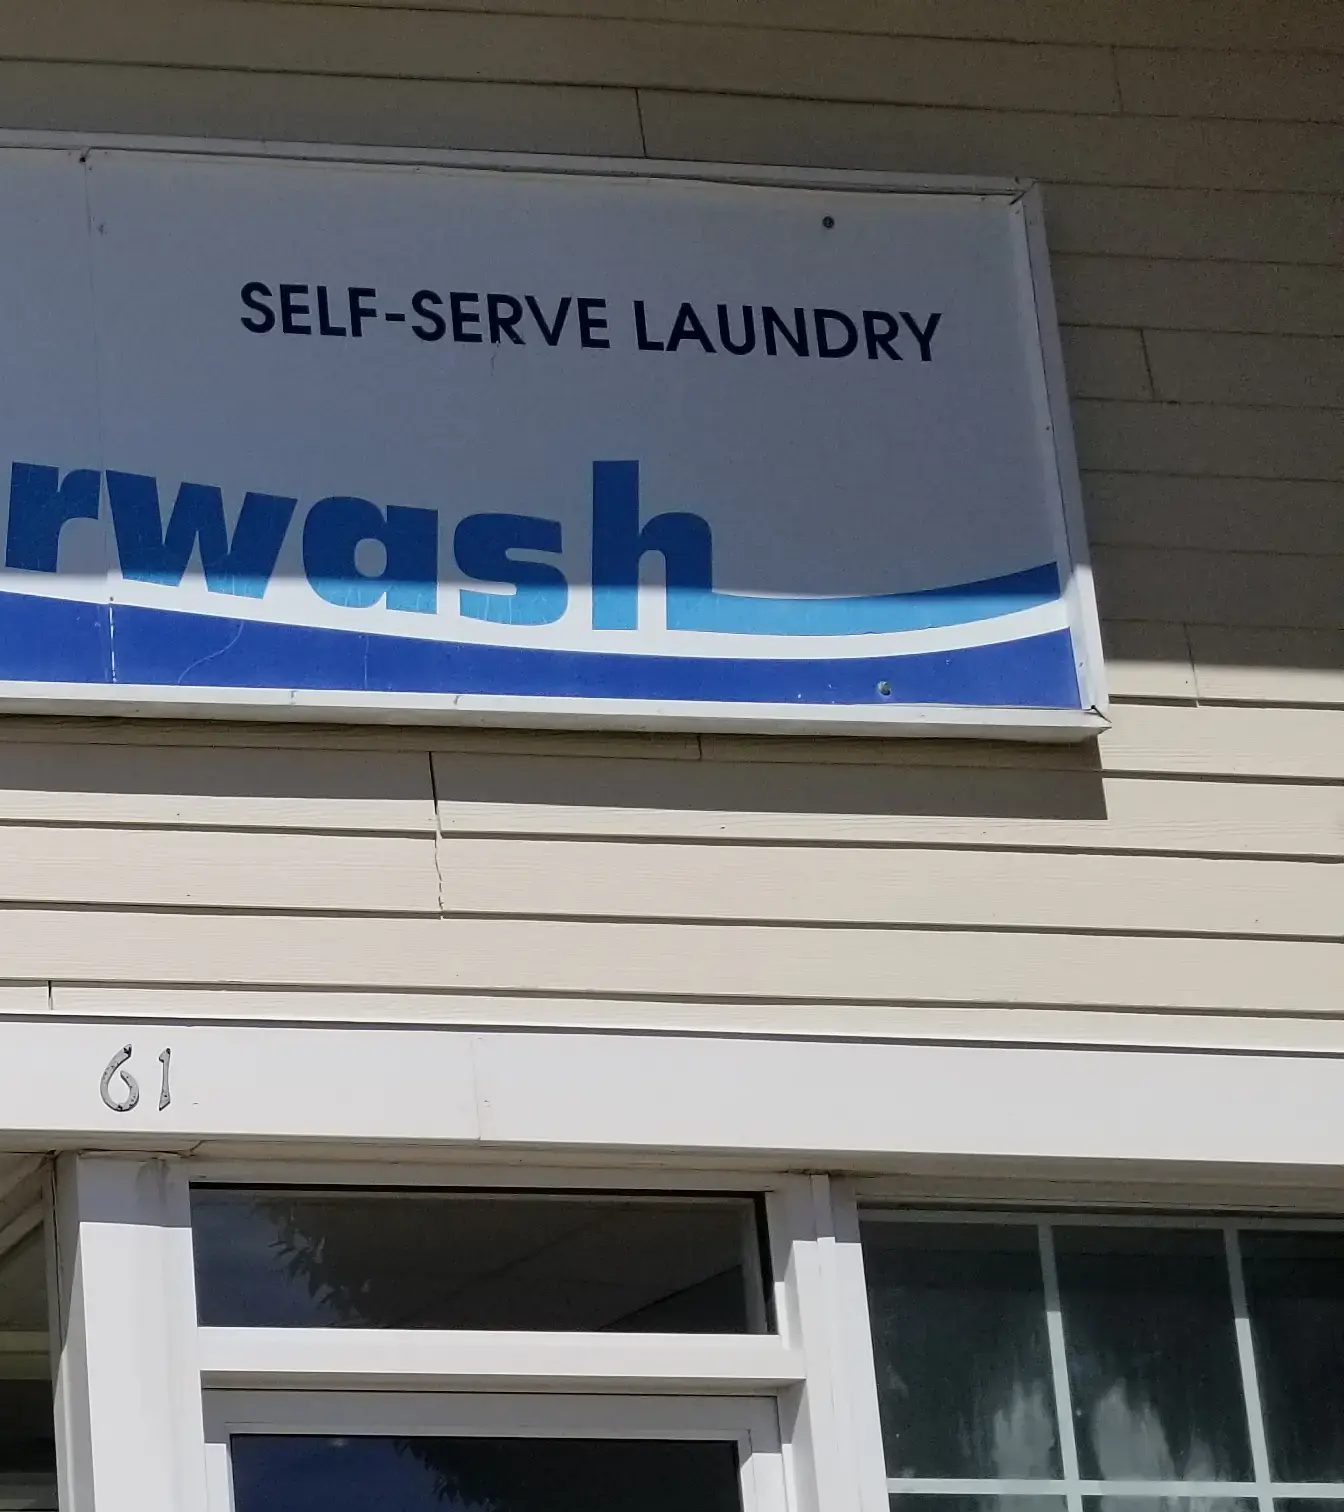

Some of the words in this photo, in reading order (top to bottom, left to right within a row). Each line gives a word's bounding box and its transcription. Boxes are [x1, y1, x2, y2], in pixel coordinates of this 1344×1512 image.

[239, 281, 611, 349] SELF-SERVE
[633, 300, 942, 363] LAUNDRY
[99, 1043, 171, 1113] 61
